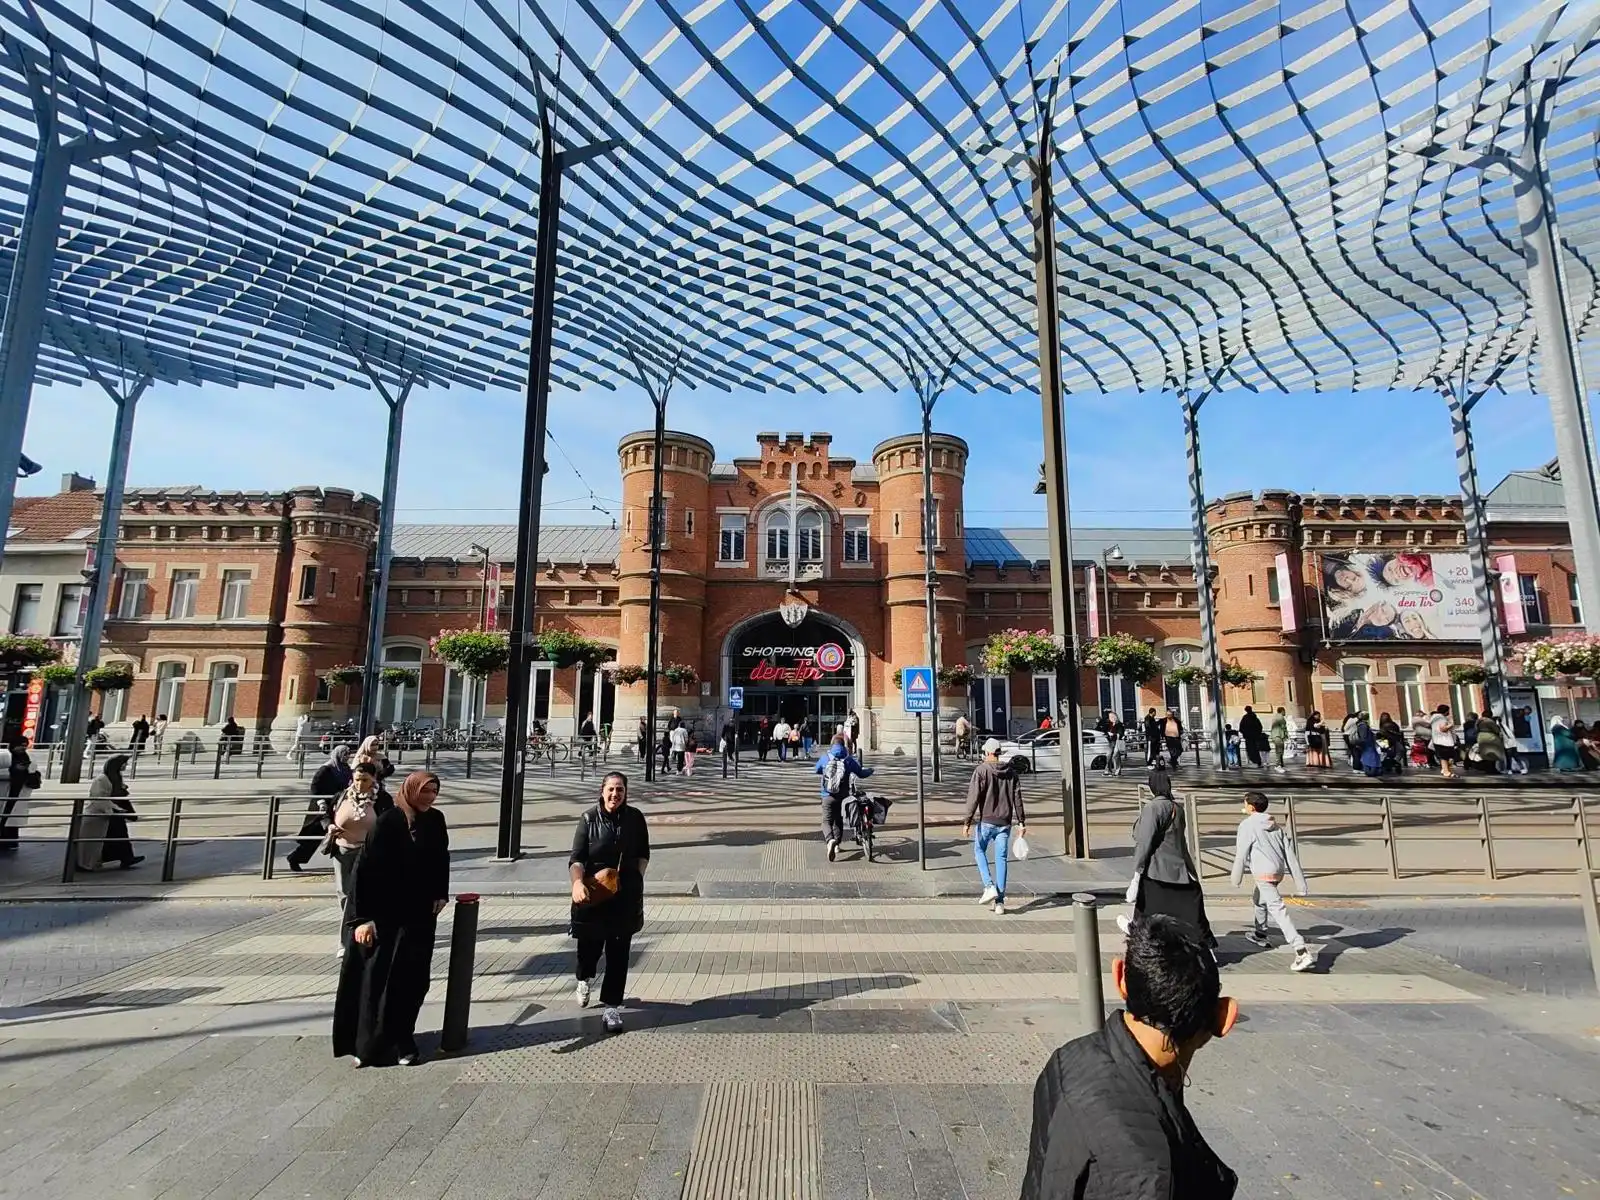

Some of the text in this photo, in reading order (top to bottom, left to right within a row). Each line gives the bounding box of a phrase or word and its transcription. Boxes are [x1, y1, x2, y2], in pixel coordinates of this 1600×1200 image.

[1398, 596, 1435, 607] den Tir
[1455, 597, 1474, 606] 340
[742, 646, 814, 657] SHOPPING
[750, 659, 787, 680] den
[793, 658, 824, 680] Tir
[908, 699, 930, 708] TRAM
